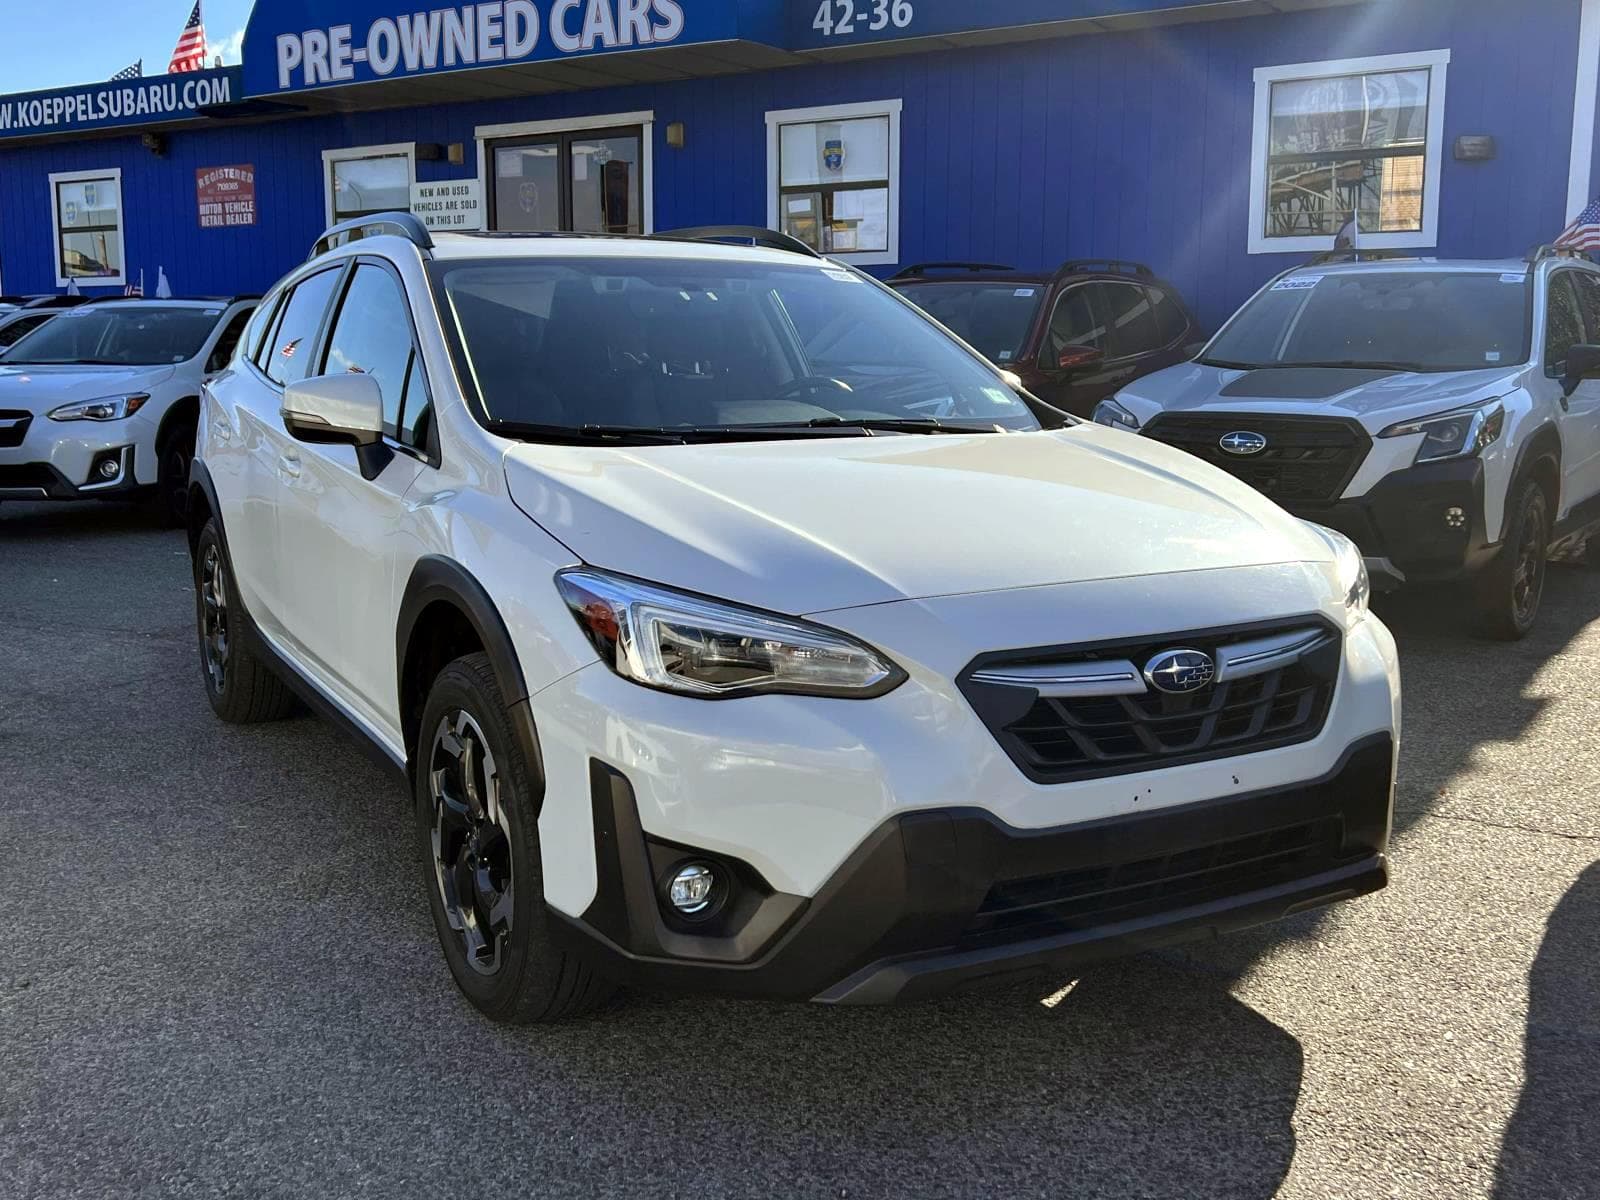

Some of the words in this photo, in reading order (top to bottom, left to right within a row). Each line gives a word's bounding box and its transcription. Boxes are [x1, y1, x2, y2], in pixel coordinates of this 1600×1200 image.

[812, 0, 913, 36] 42-36
[276, 0, 540, 89] PRE-OWNED
[549, 0, 684, 52] CARS
[198, 168, 254, 189] REGISTERED
[420, 188, 434, 197] NEW
[436, 186, 450, 196] AND
[452, 185, 470, 196] USED
[199, 203, 223, 215] MOTOR
[224, 201, 254, 213] VEHICLE
[413, 201, 443, 212] VEHICLES
[445, 200, 458, 210] ARE
[460, 199, 478, 209] SOLD
[201, 214, 225, 227] RETAIL
[225, 213, 253, 225] DEALER
[425, 215, 435, 226] ON
[437, 215, 451, 225] THIS
[453, 214, 465, 225] LOT
